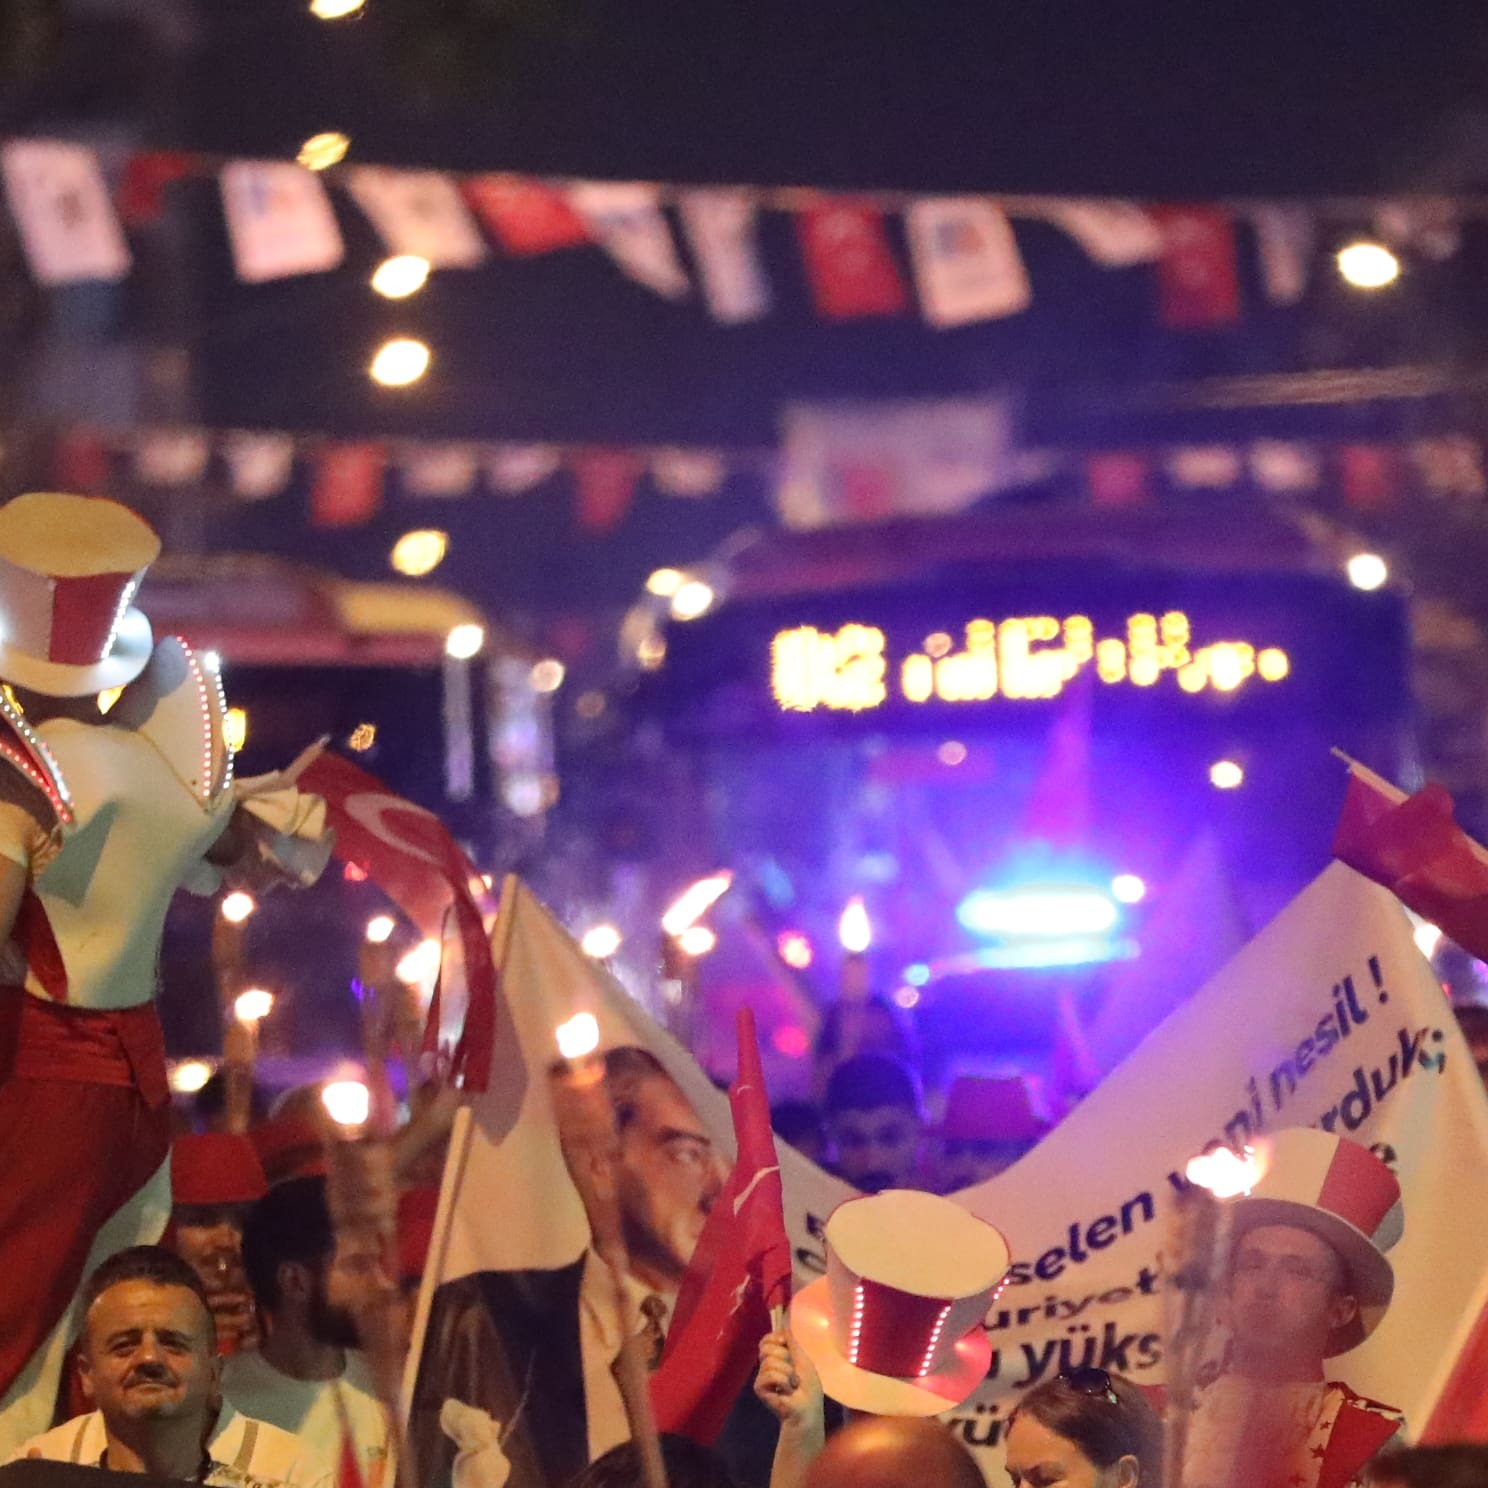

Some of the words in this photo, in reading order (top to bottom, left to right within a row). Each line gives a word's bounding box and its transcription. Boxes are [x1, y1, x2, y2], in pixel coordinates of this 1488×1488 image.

[1008, 1191, 1155, 1285] selen
[1269, 973, 1369, 1112] nesil
[1319, 1024, 1447, 1134] rduk;
